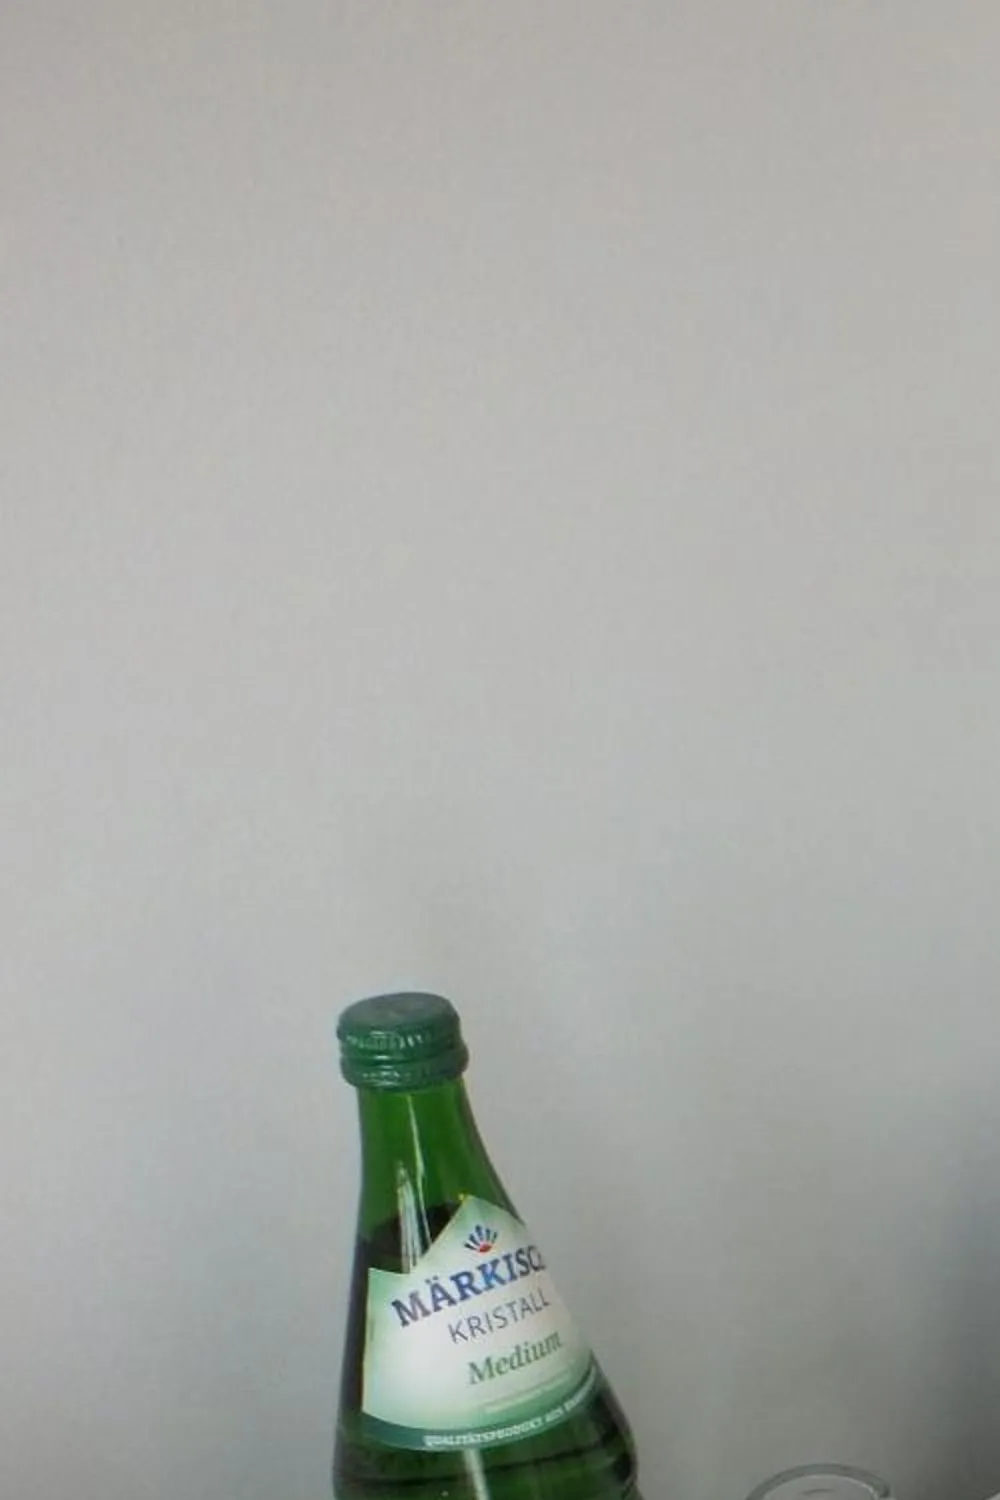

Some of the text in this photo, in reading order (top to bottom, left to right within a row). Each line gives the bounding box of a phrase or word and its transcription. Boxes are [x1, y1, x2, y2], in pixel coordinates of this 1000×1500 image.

[391, 1245, 547, 1328] MÄRKISC
[448, 1288, 552, 1345] KRISTALL
[467, 1330, 563, 1386] Medium
